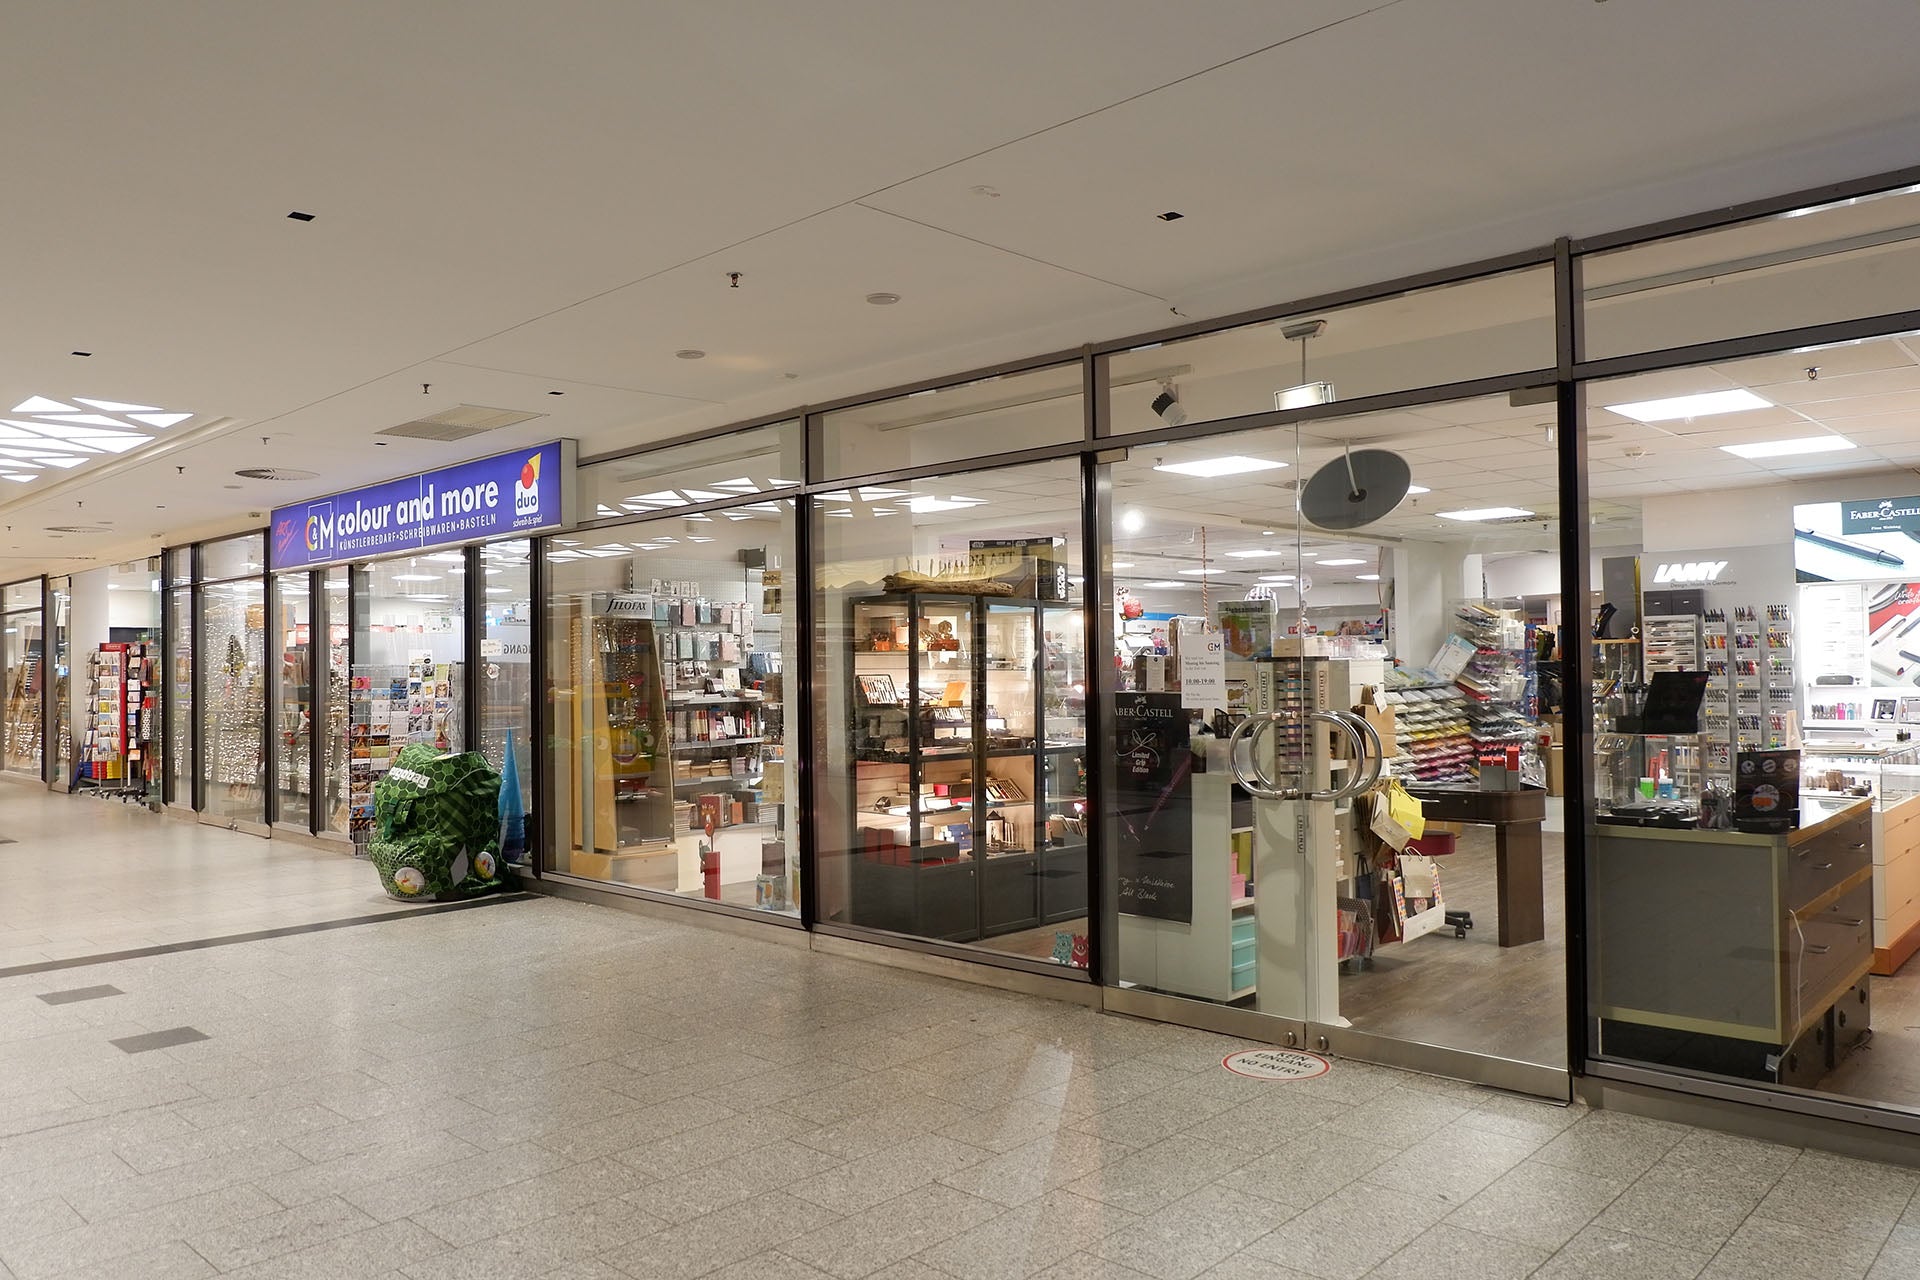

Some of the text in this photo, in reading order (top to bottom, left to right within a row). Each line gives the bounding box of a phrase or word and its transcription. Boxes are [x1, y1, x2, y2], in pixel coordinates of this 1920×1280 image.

[337, 481, 499, 536] colour and more
[517, 491, 537, 509] duo
[1653, 561, 1728, 583] LAMY
[1255, 1053, 1315, 1069] EINGANG
[1276, 1052, 1310, 1062] KEIN
[1237, 1058, 1304, 1076] NO ENTRY
